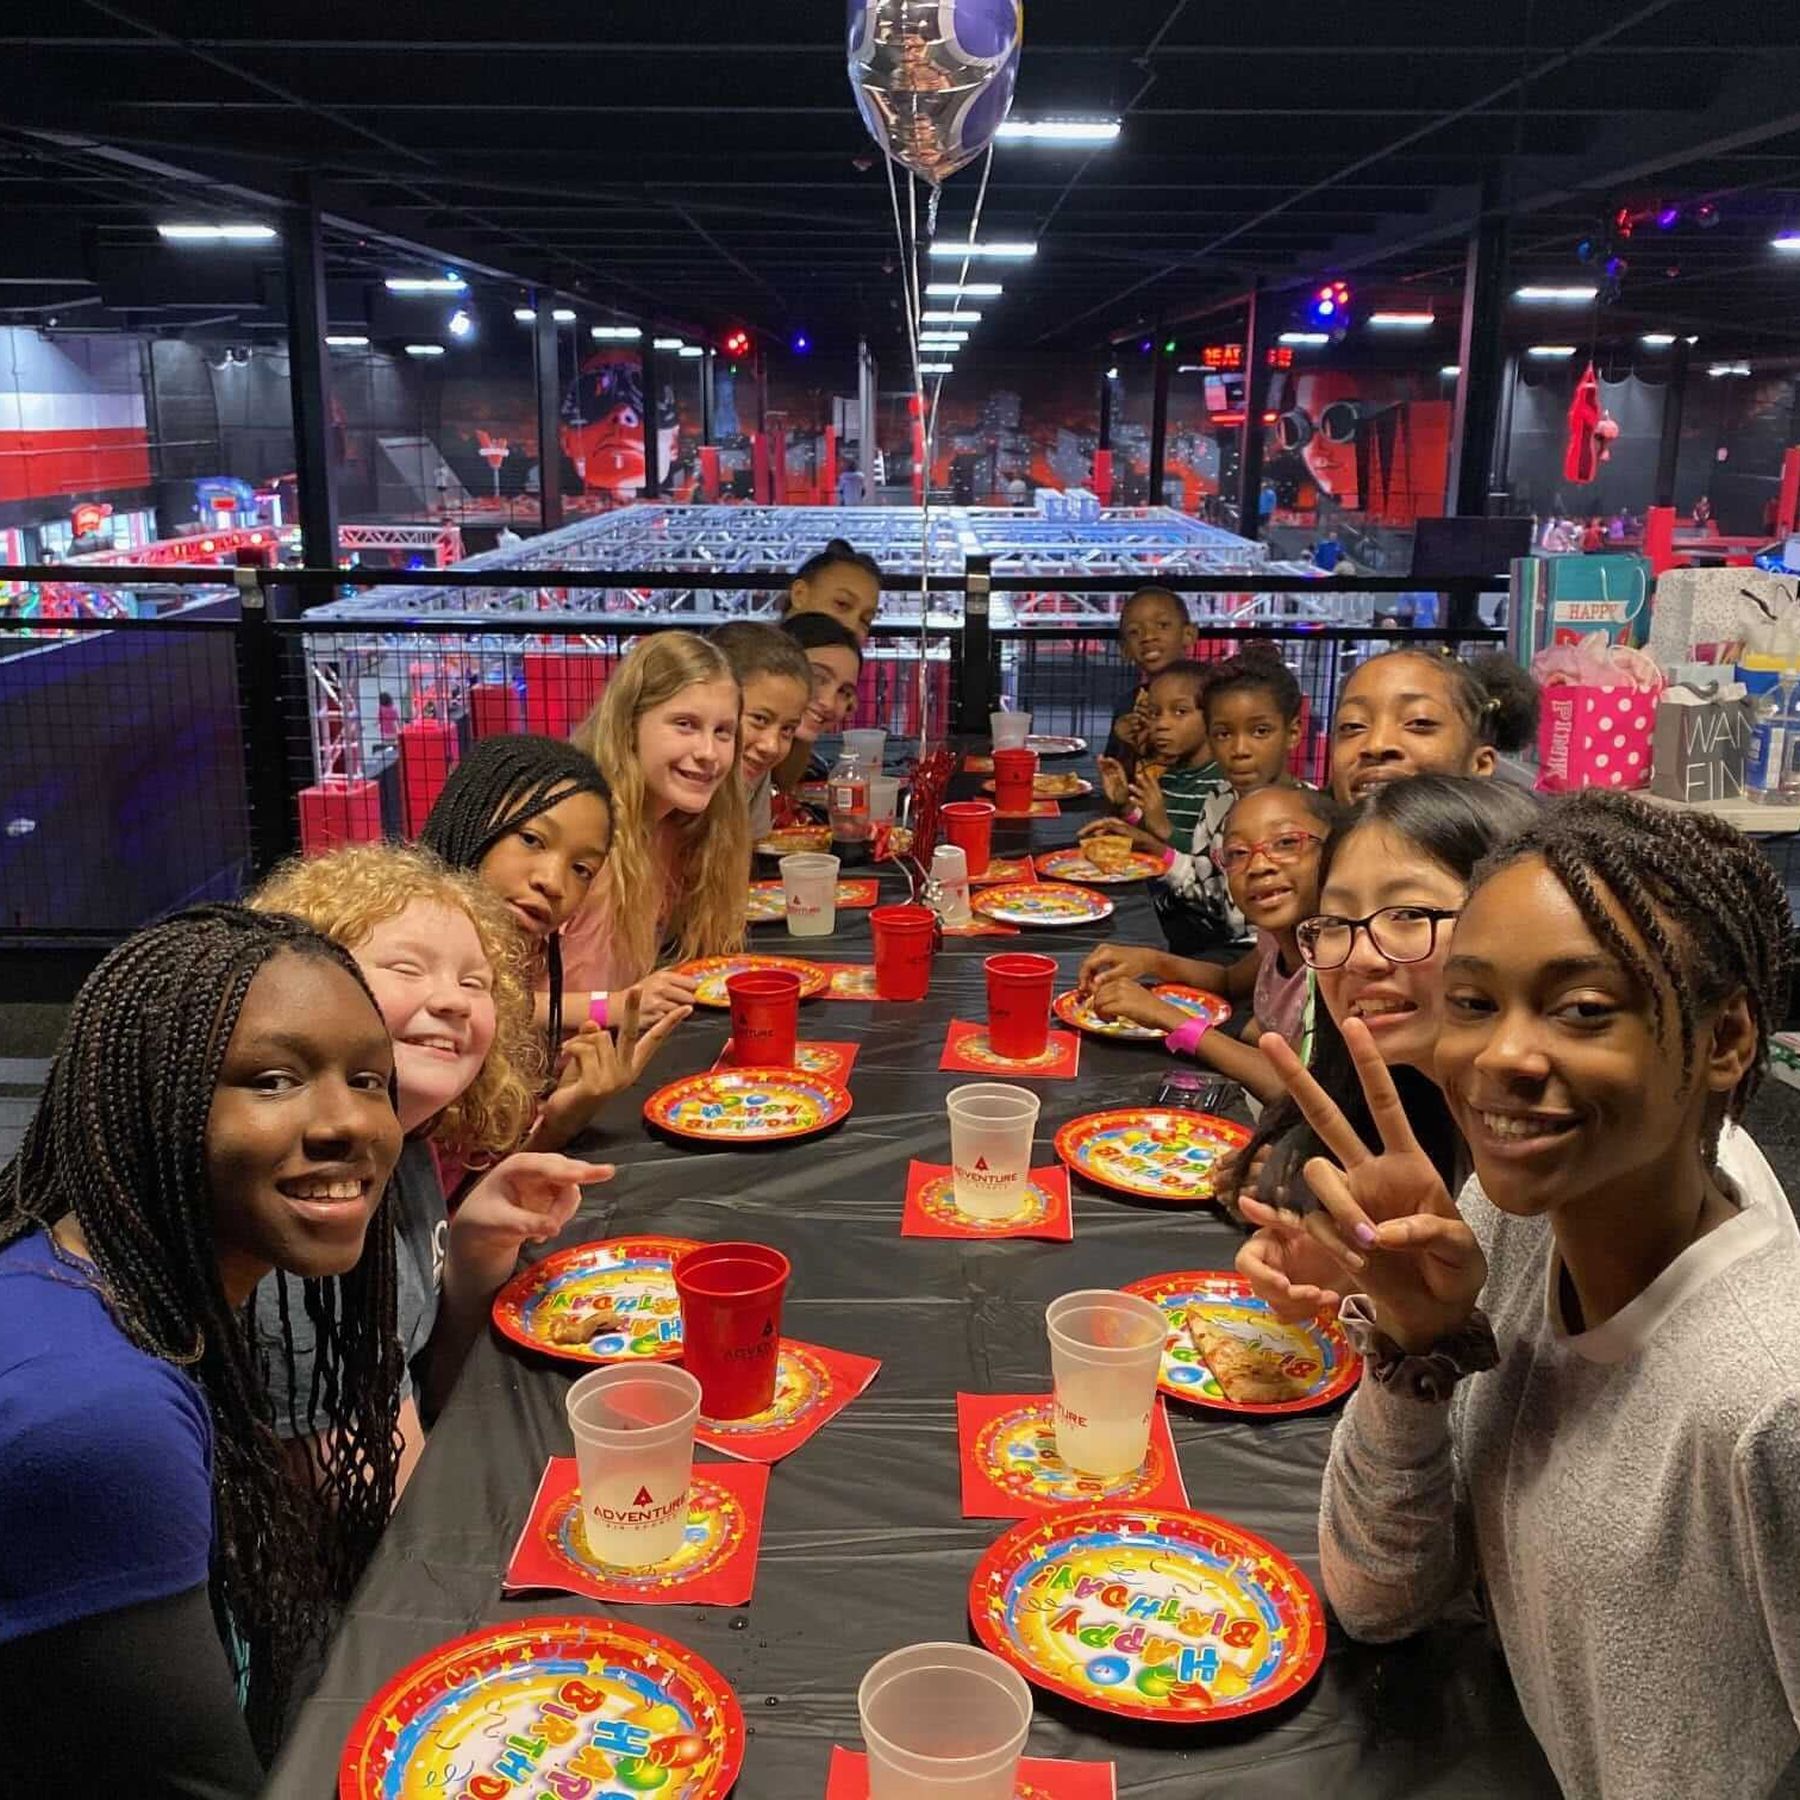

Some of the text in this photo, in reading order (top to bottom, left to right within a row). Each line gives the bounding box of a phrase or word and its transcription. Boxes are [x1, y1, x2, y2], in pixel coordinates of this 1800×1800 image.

[1569, 603, 1617, 620] HAPPY
[1547, 700, 1573, 780] PINK
[700, 1104, 802, 1119] HAPPY
[1049, 1605, 1224, 1684] HAPPY
